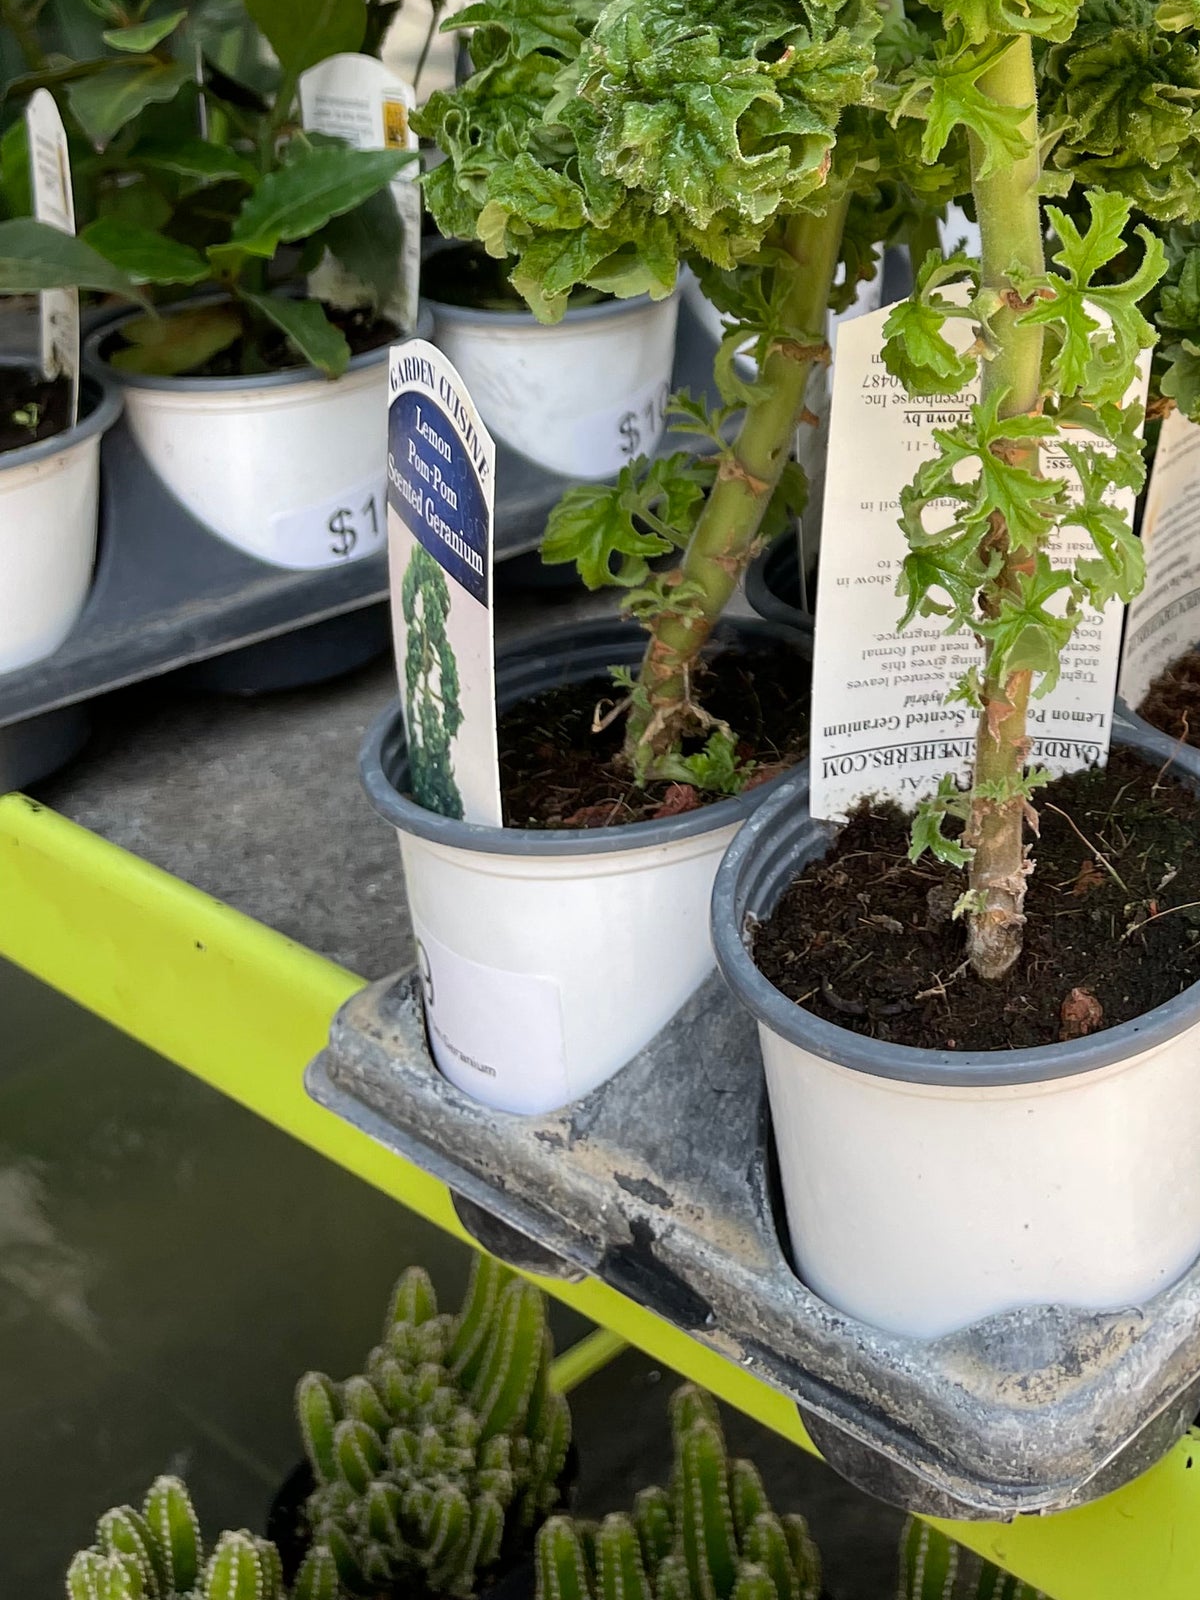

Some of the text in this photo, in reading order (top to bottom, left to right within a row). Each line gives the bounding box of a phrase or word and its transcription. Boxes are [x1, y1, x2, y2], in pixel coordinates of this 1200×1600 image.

[862, 374, 901, 388] 0487
[860, 394, 977, 409] Greenhouse Inc.
[389, 355, 490, 483] GARDEN CUISINE
[902, 412, 921, 427] by
[415, 404, 453, 463] Lemon
[408, 437, 459, 511] Pom-Pom
[387, 451, 485, 577] Scented Geranium
[860, 502, 874, 512] in
[877, 560, 891, 570] to
[836, 574, 892, 588] show in
[872, 628, 941, 643] fragrance.
[861, 646, 907, 661] formal
[911, 644, 937, 656] and
[941, 643, 969, 653] neat
[881, 661, 906, 673] this
[911, 655, 947, 669] gives
[1074, 658, 1100, 668] and
[846, 677, 889, 691] leaves
[893, 672, 945, 687] scented
[823, 715, 900, 738] Geranium
[906, 710, 967, 729] Scented
[1052, 710, 1105, 728] Lemon
